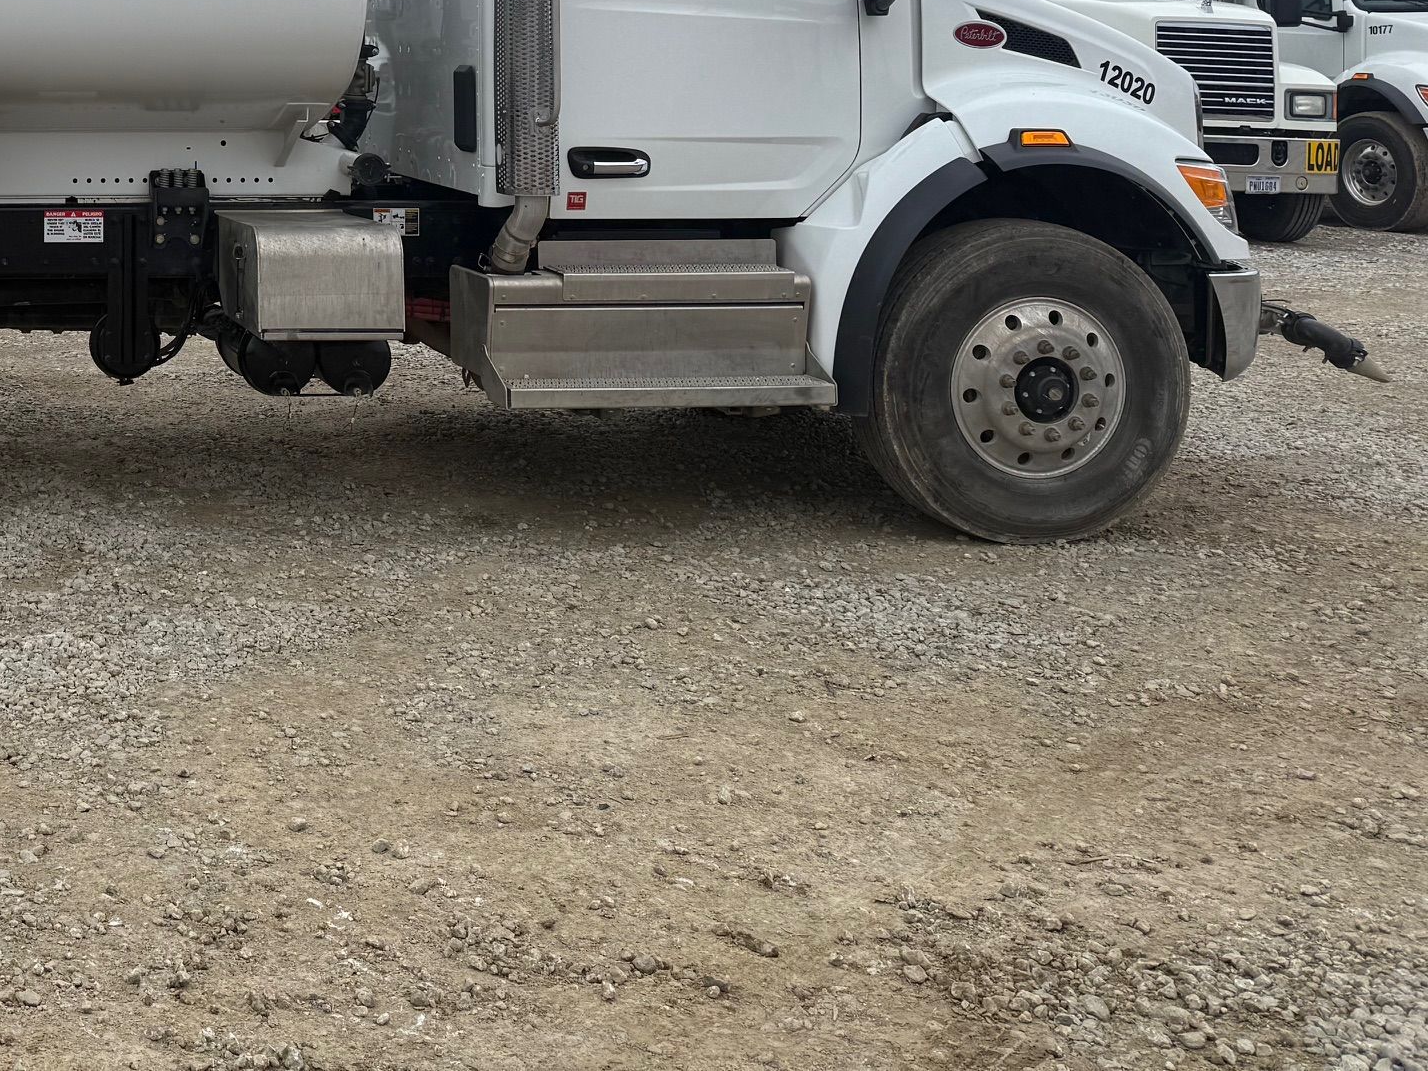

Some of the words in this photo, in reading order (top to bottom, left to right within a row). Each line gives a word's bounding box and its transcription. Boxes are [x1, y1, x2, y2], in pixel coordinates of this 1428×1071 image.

[960, 25, 1001, 42] Peterbilt
[1368, 24, 1394, 35] 10177
[1099, 60, 1156, 105] 12020
[1224, 97, 1267, 105] MACK
